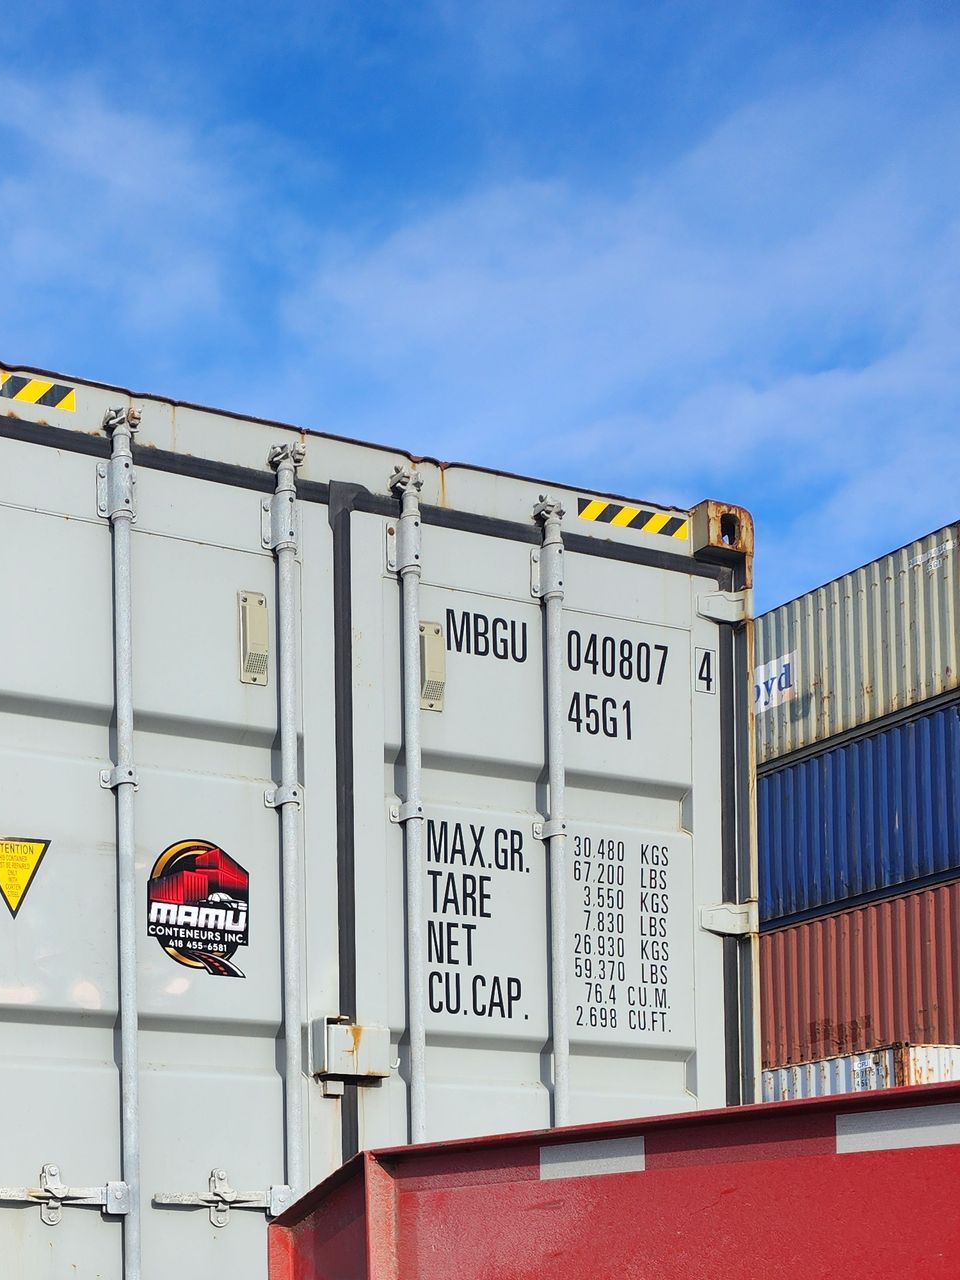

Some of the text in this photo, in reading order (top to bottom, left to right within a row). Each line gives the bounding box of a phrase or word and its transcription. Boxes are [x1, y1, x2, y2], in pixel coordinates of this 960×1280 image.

[445, 608, 713, 692] MBGU 040807 4
[567, 691, 632, 741] 45G1
[426, 819, 530, 873] MAX.GR.
[641, 844, 669, 867] KGS
[641, 867, 667, 890] LBS
[426, 869, 492, 918] TARE
[640, 891, 669, 914] KGS
[149, 902, 247, 932] MAMU
[640, 916, 667, 938] LBS
[148, 925, 221, 941] CONTENEURS
[427, 920, 477, 966] NET
[168, 939, 227, 952] 418 455-6581
[641, 939, 669, 961] KGS
[641, 963, 668, 985] LBS
[428, 971, 529, 1020] CU.CAP.
[584, 982, 617, 1005] 76.4
[628, 1009, 672, 1032] CU.FT.
